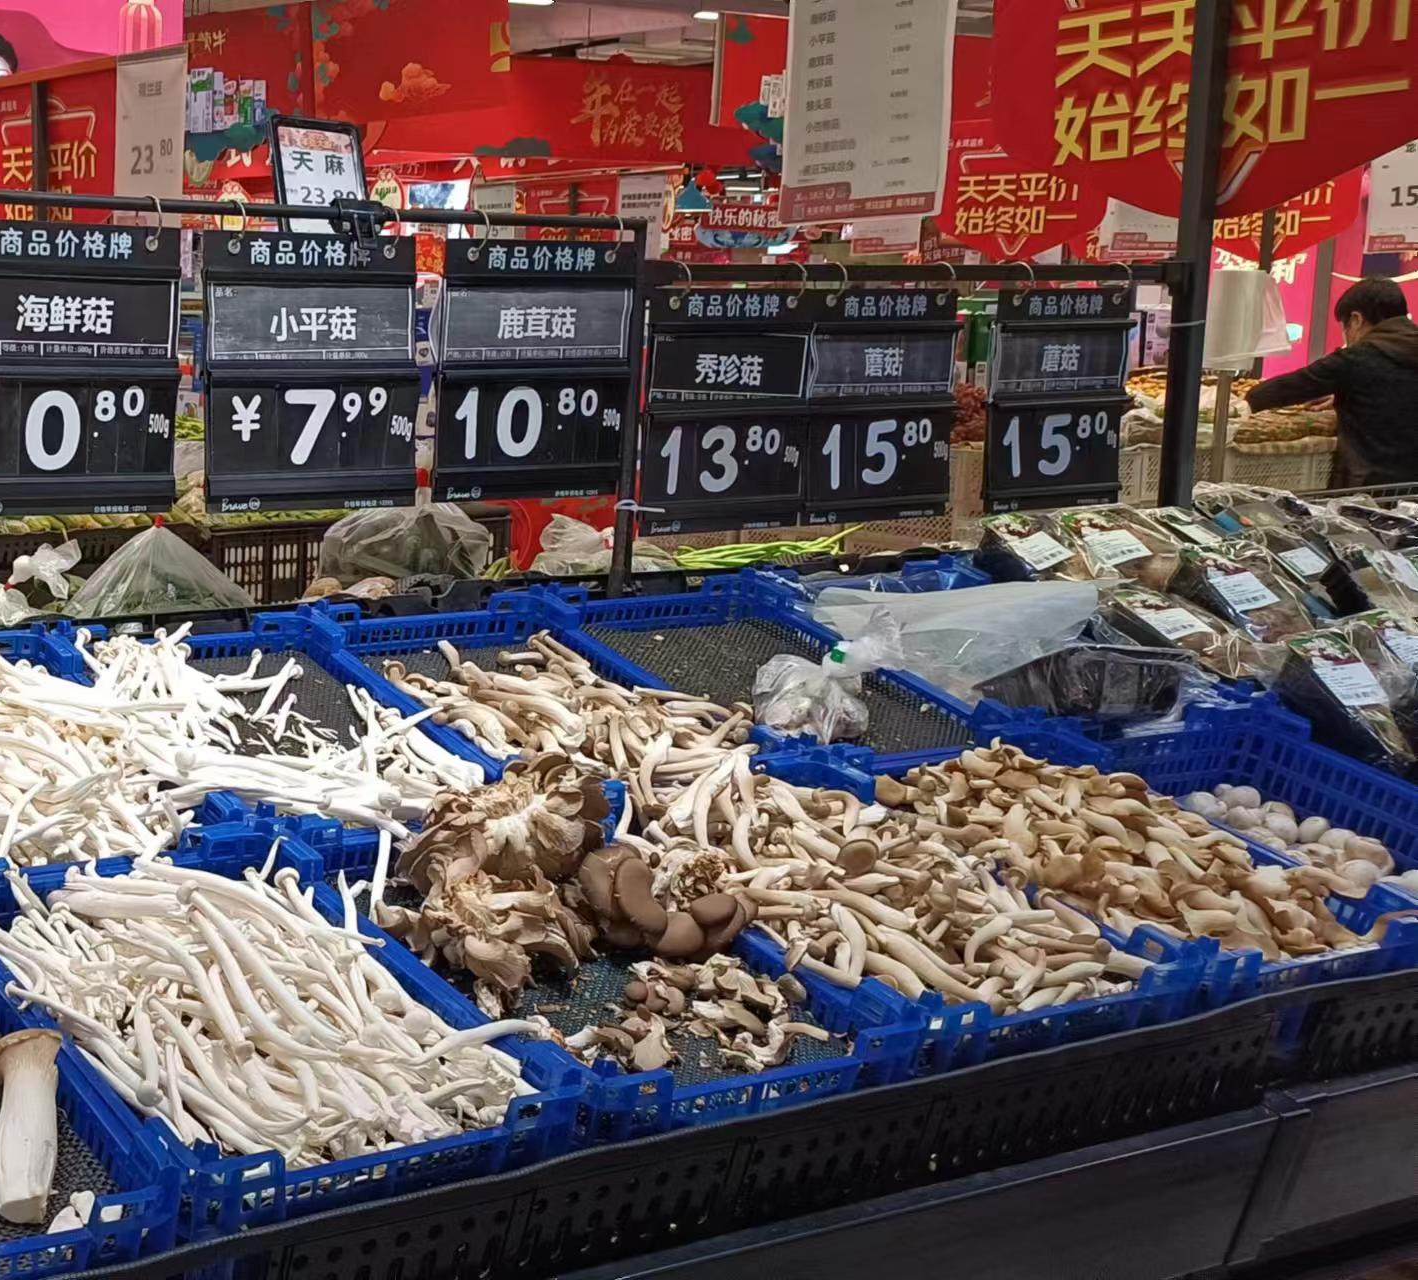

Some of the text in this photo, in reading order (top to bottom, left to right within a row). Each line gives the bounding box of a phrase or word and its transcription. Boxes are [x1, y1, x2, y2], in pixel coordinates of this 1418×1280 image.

[1053, 66, 1410, 166] 始终如一
[956, 173, 1078, 203] 天天平价
[709, 208, 781, 227] 快乐的秘密
[954, 206, 1077, 235] 始终如一
[0, 227, 133, 259] 商品价格牌
[250, 238, 372, 267] 商品价格牌
[488, 245, 596, 272] 商品价格牌
[16, 294, 114, 334] 海鲜菇
[687, 293, 781, 318] 商品价格牌
[844, 295, 927, 317] 商品价格牌
[1029, 294, 1103, 316] 商品价格牌
[270, 306, 357, 342] 小平菇
[498, 307, 577, 340] 鹿茸菇
[695, 354, 764, 386] 秀珍菇
[864, 347, 905, 377] 蘑菇
[1041, 344, 1081, 372] 蘑菇
[148, 414, 170, 438] 500g
[232, 394, 262, 442] ¥
[390, 415, 413, 442] 500g
[602, 409, 621, 431] 500g
[222, 498, 248, 512] Bravo
